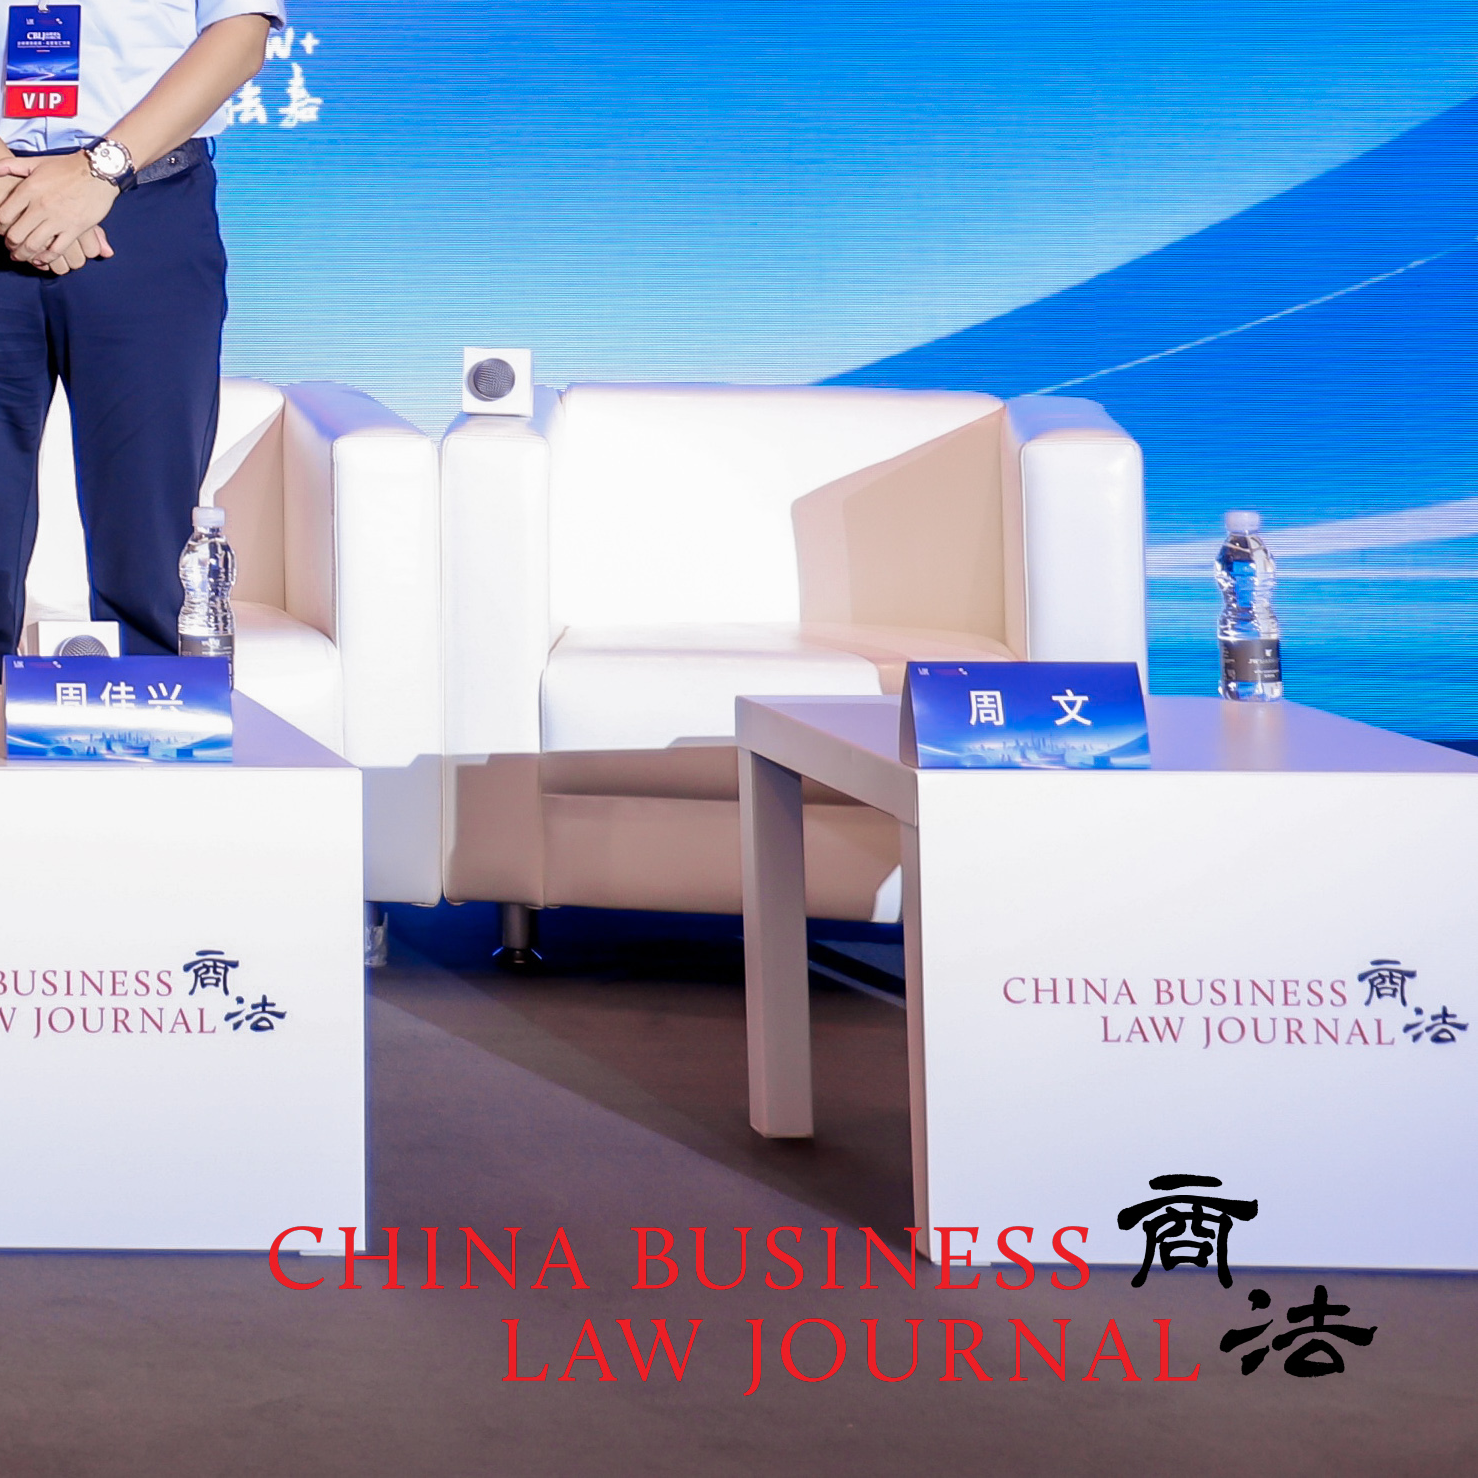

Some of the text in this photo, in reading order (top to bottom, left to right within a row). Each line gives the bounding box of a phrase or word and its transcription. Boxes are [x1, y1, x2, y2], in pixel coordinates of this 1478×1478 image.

[22, 92, 62, 110] VIP
[1003, 977, 1347, 1007] CHINA BUSINESS
[34, 1006, 217, 1039] JOURNAL
[1101, 1016, 1395, 1049] LAW JOURNAL
